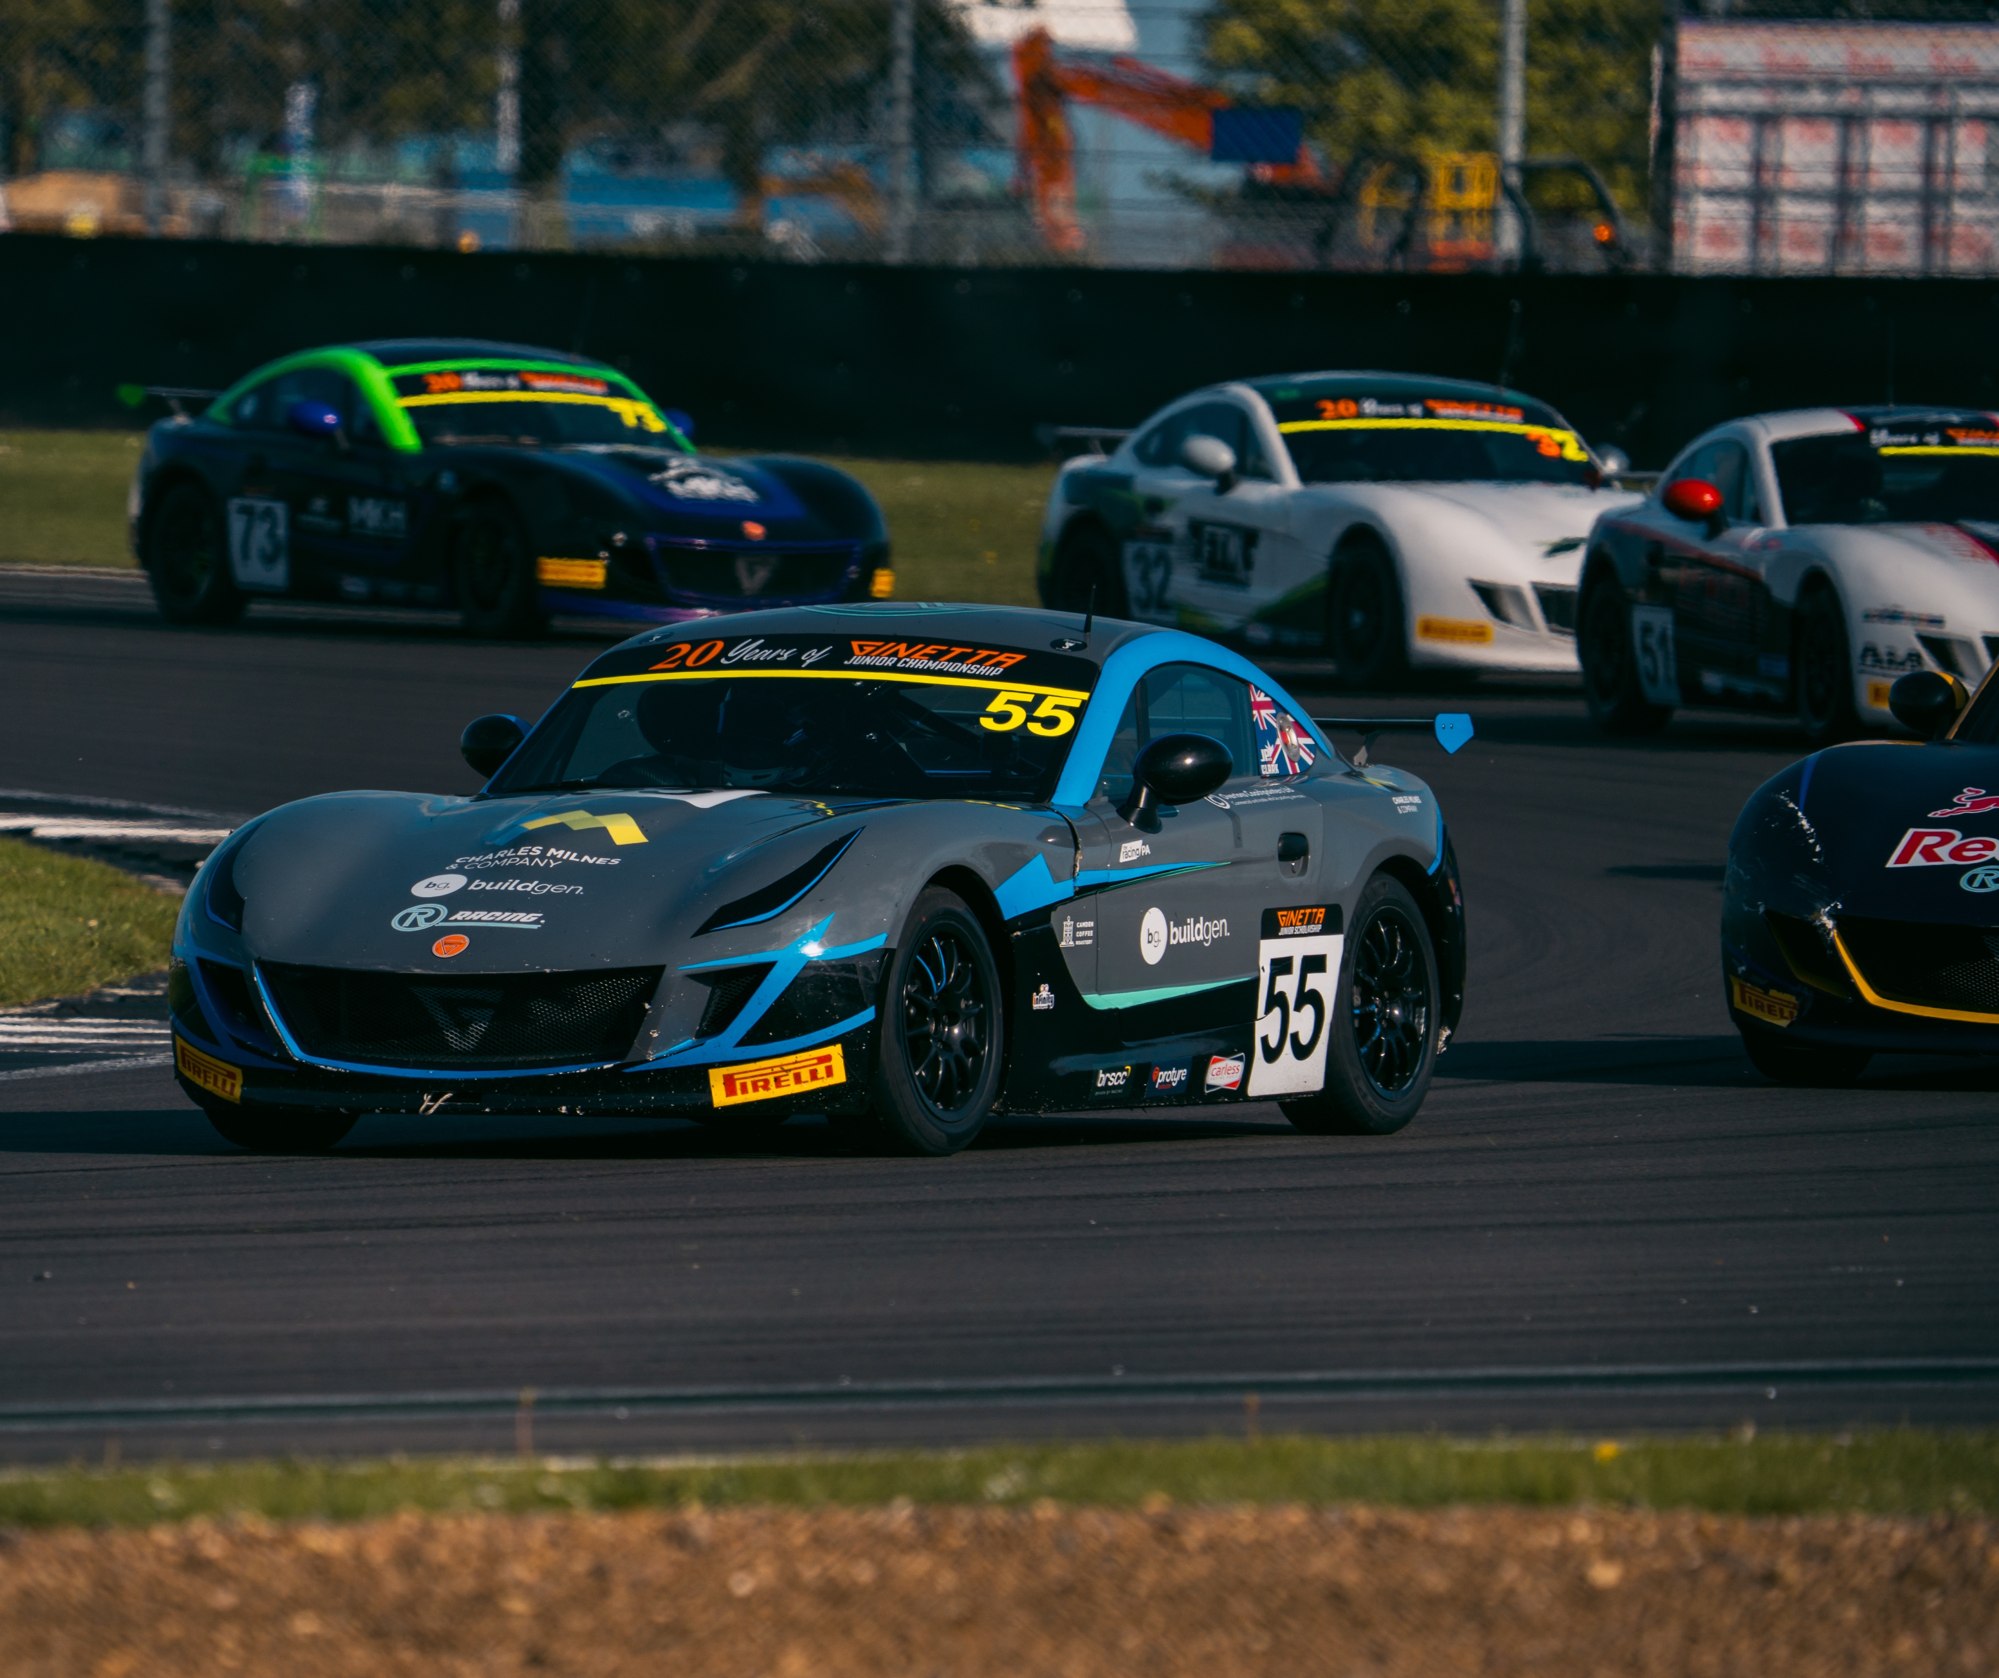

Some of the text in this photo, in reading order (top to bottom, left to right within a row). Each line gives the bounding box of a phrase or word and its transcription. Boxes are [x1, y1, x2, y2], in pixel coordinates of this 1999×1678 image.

[1315, 398, 1358, 419] 20
[235, 503, 281, 570] 73
[1133, 546, 1173, 609] 32
[648, 638, 834, 671] 20 Years of
[844, 655, 1004, 677] JUNIOR CHAMPIONSHIP
[849, 639, 1028, 669] GINETTA
[1639, 620, 1675, 688] 51
[979, 690, 1082, 738] 55
[455, 846, 622, 866] CHARLES MILNES
[1888, 829, 1999, 866] Re
[445, 857, 562, 871] & COMPANY
[467, 878, 584, 895] buildgen.
[1169, 916, 1230, 947] buildgen.
[1276, 907, 1326, 927] GINETTA
[1260, 954, 1327, 1064] 55
[180, 1045, 237, 1097] PIRELLI
[722, 1053, 834, 1098] PIRELLI
[1096, 1068, 1129, 1088] brscc
[1155, 1067, 1188, 1089] protyre
[1211, 1063, 1241, 1077] carless
